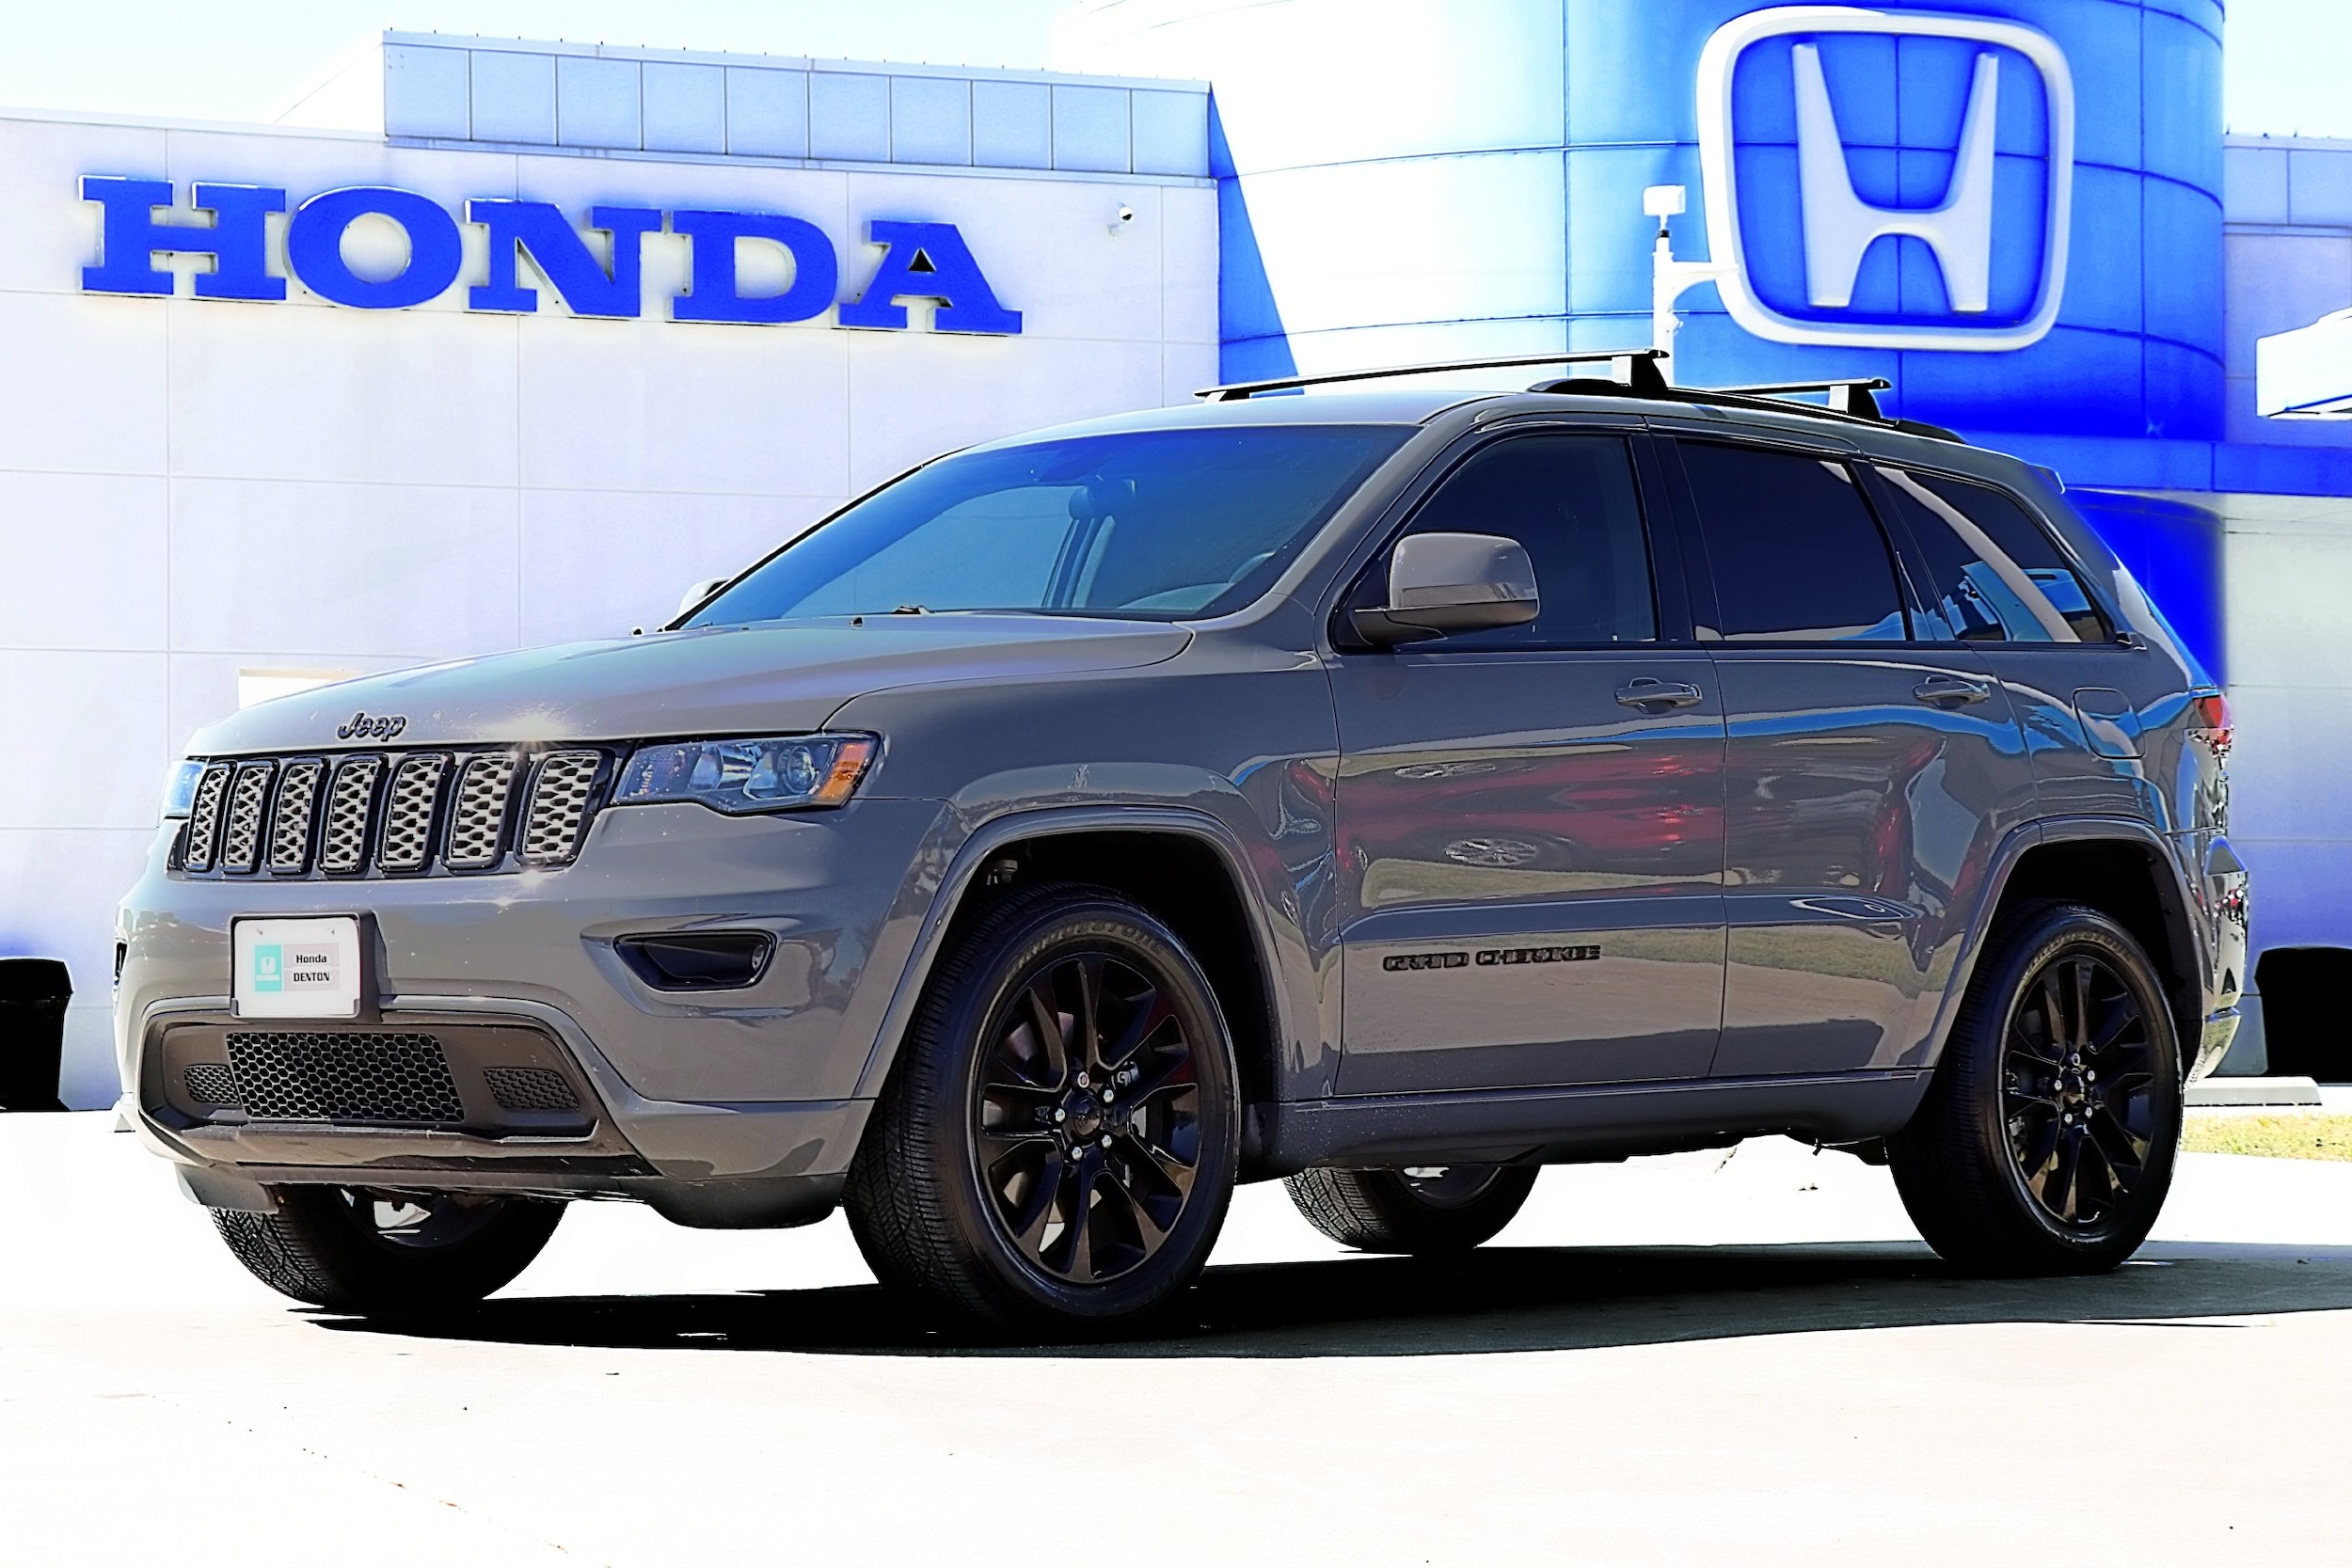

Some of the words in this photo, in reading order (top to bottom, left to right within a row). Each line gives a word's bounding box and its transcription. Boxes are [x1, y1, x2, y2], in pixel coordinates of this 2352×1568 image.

[80, 174, 1024, 334] HONDA
[338, 712, 406, 742] Jeep
[295, 954, 327, 964] Honda
[294, 972, 330, 982] DENTON
